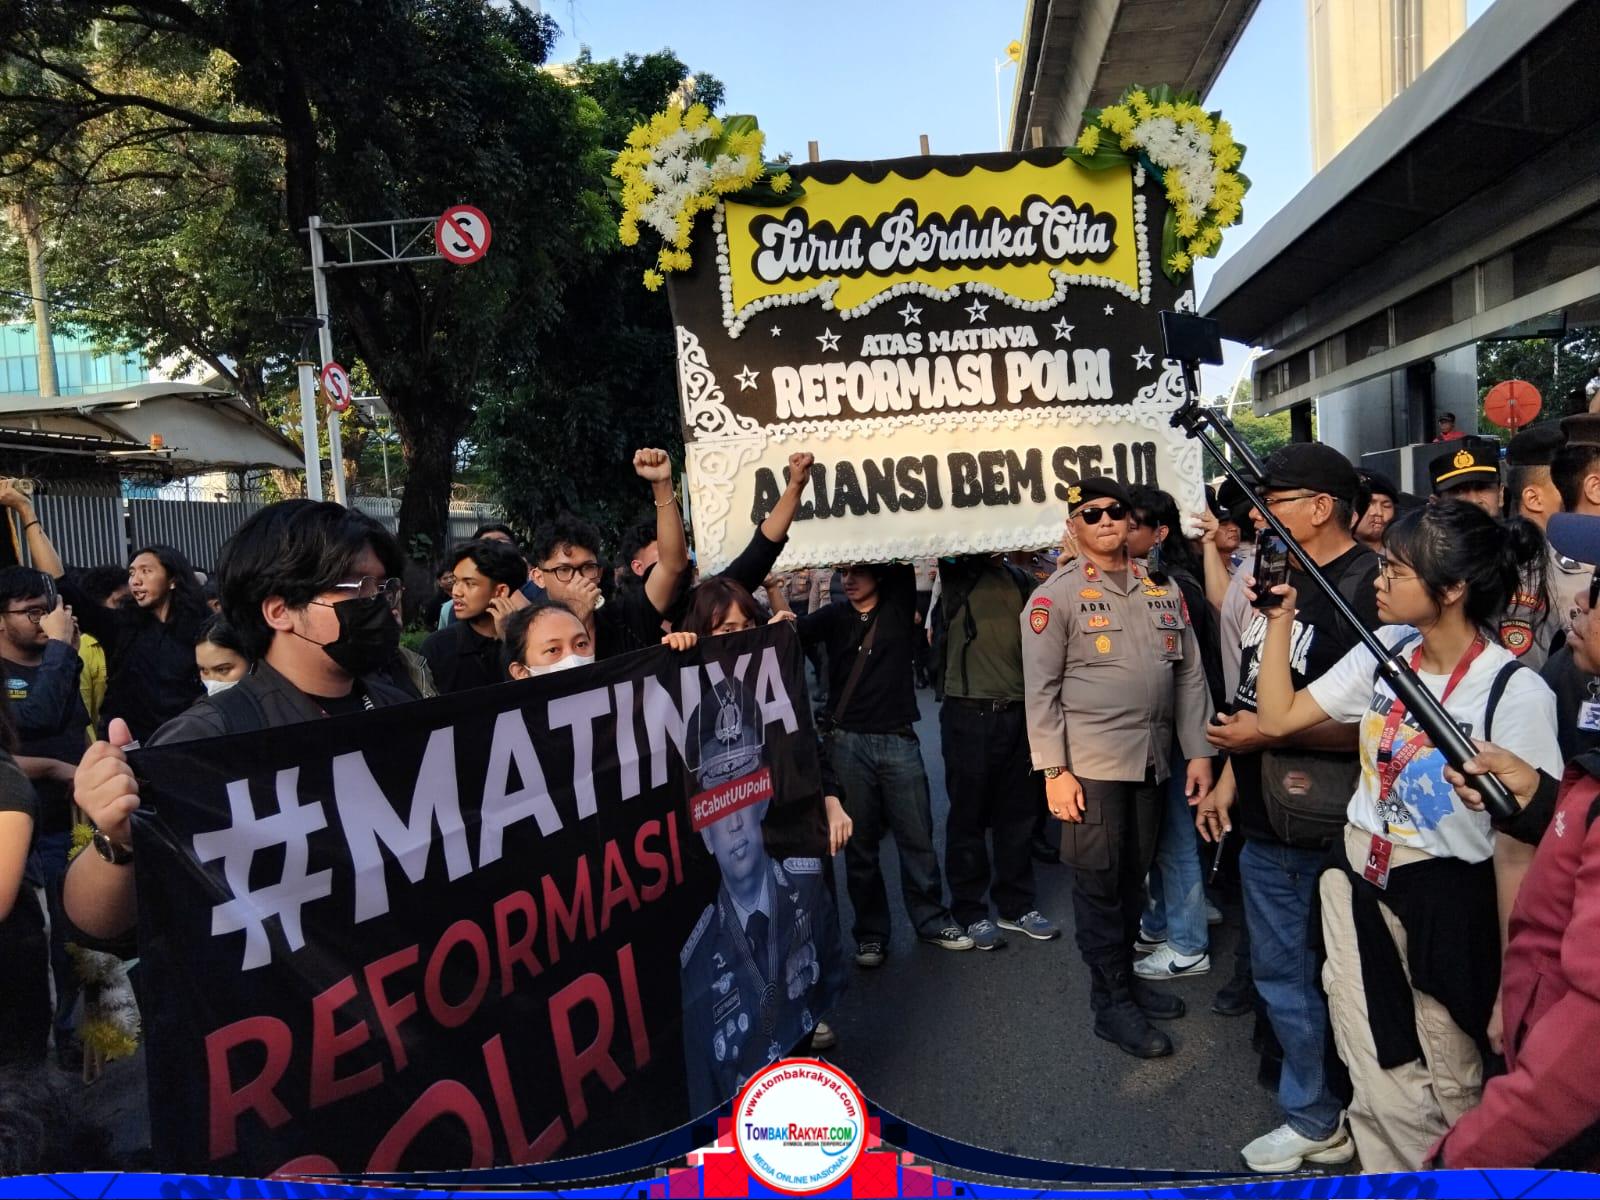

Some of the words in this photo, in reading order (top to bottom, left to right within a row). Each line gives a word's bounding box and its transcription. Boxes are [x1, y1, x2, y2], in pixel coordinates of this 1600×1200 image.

[757, 218, 865, 281] Turut
[868, 208, 1037, 268] Berduka
[1027, 201, 1111, 259] Cita
[860, 333, 923, 357] ATAS
[928, 325, 1039, 353] MATINYA
[771, 352, 996, 420] REFORMASI
[1004, 348, 1113, 403] POLRI
[947, 447, 1047, 508] BEM
[1080, 603, 1111, 613] ADRI
[1147, 599, 1177, 609] POLRI
[192, 646, 799, 972] #MATINYA
[694, 773, 771, 821] #CabutUUPolri
[204, 811, 685, 1161] REFORMASI
[266, 942, 652, 1182] OLRI
